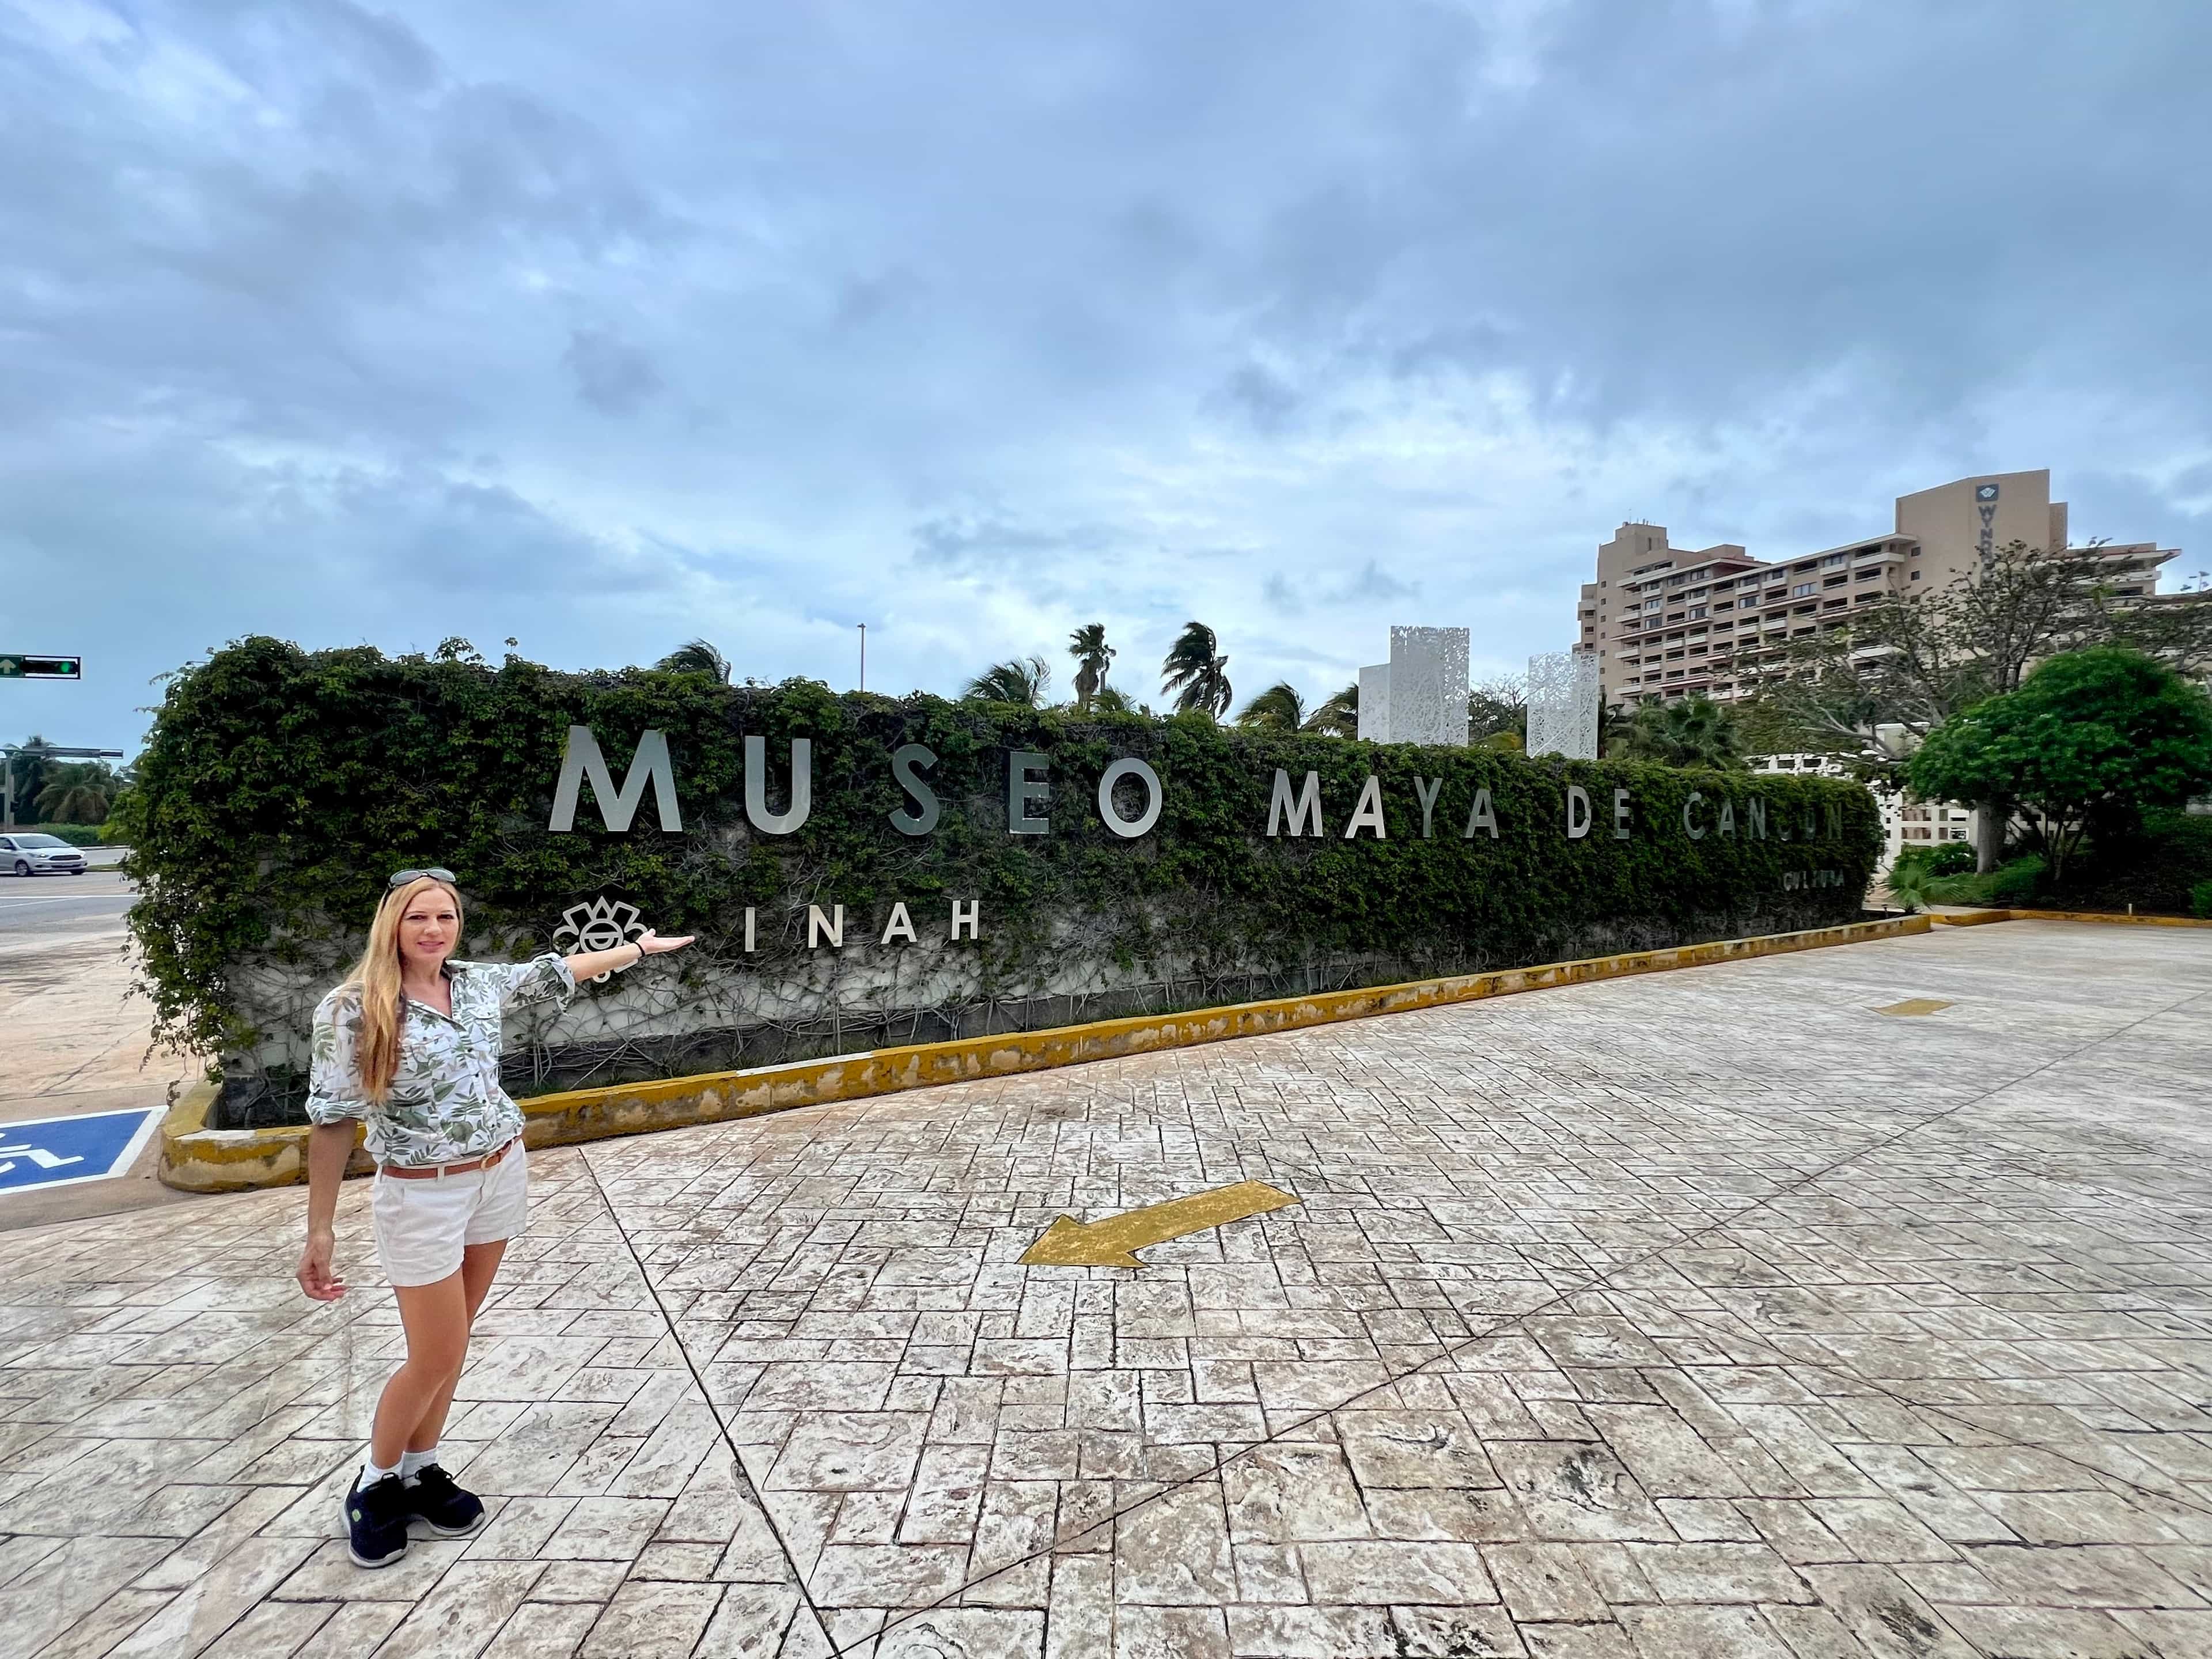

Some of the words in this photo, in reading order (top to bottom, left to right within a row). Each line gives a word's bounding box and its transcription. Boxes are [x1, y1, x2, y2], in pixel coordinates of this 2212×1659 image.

[1978, 504, 1997, 587] WYNDH
[548, 725, 1162, 838] MUSEO
[1266, 767, 1499, 839] MAYA
[1567, 785, 1630, 839] DE
[744, 900, 979, 952] INAH
